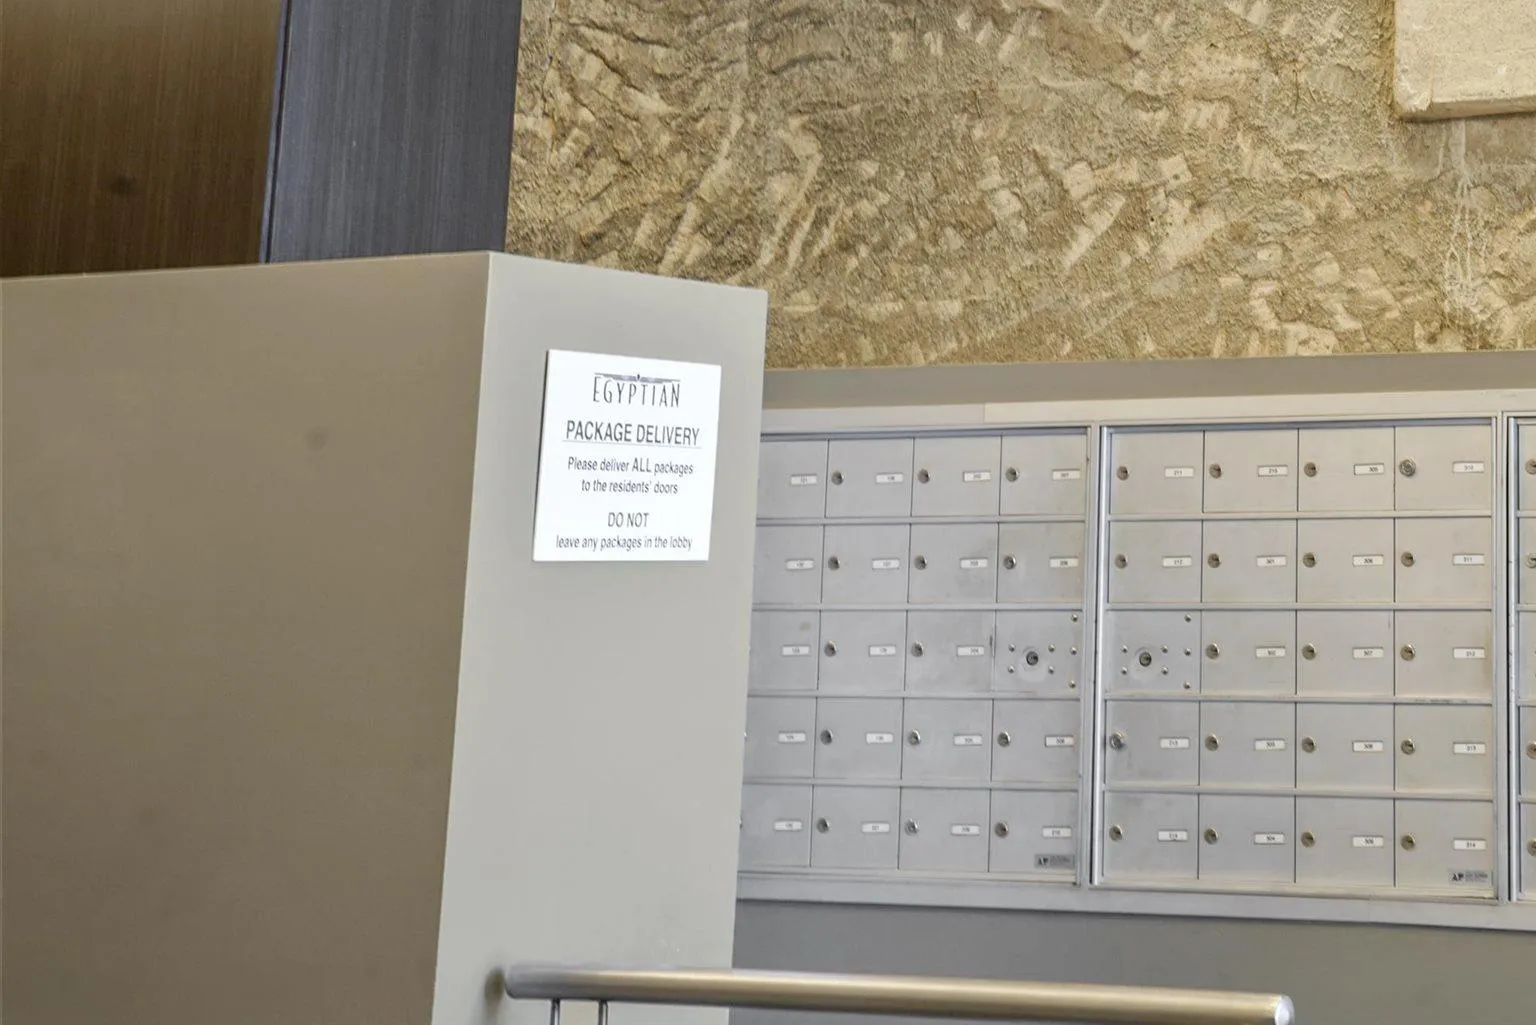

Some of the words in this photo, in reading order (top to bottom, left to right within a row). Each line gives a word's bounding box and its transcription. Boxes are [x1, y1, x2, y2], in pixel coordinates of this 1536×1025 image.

[593, 376, 680, 408] EGYPTIAN
[566, 420, 632, 442] PACKAGE
[636, 425, 700, 446] DELIVERY
[568, 457, 598, 471] Please
[600, 458, 629, 473] deliver
[632, 458, 652, 473] ALL
[654, 461, 693, 477] packages
[581, 480, 590, 492] to
[593, 480, 607, 492] the
[654, 481, 678, 494] doors
[608, 512, 624, 528] DO
[627, 512, 649, 528] NOT
[556, 535, 580, 549] leave
[582, 537, 598, 552] any
[600, 535, 642, 551] packages
[644, 535, 652, 549] in
[654, 536, 667, 549] the
[670, 536, 692, 551] lobby
